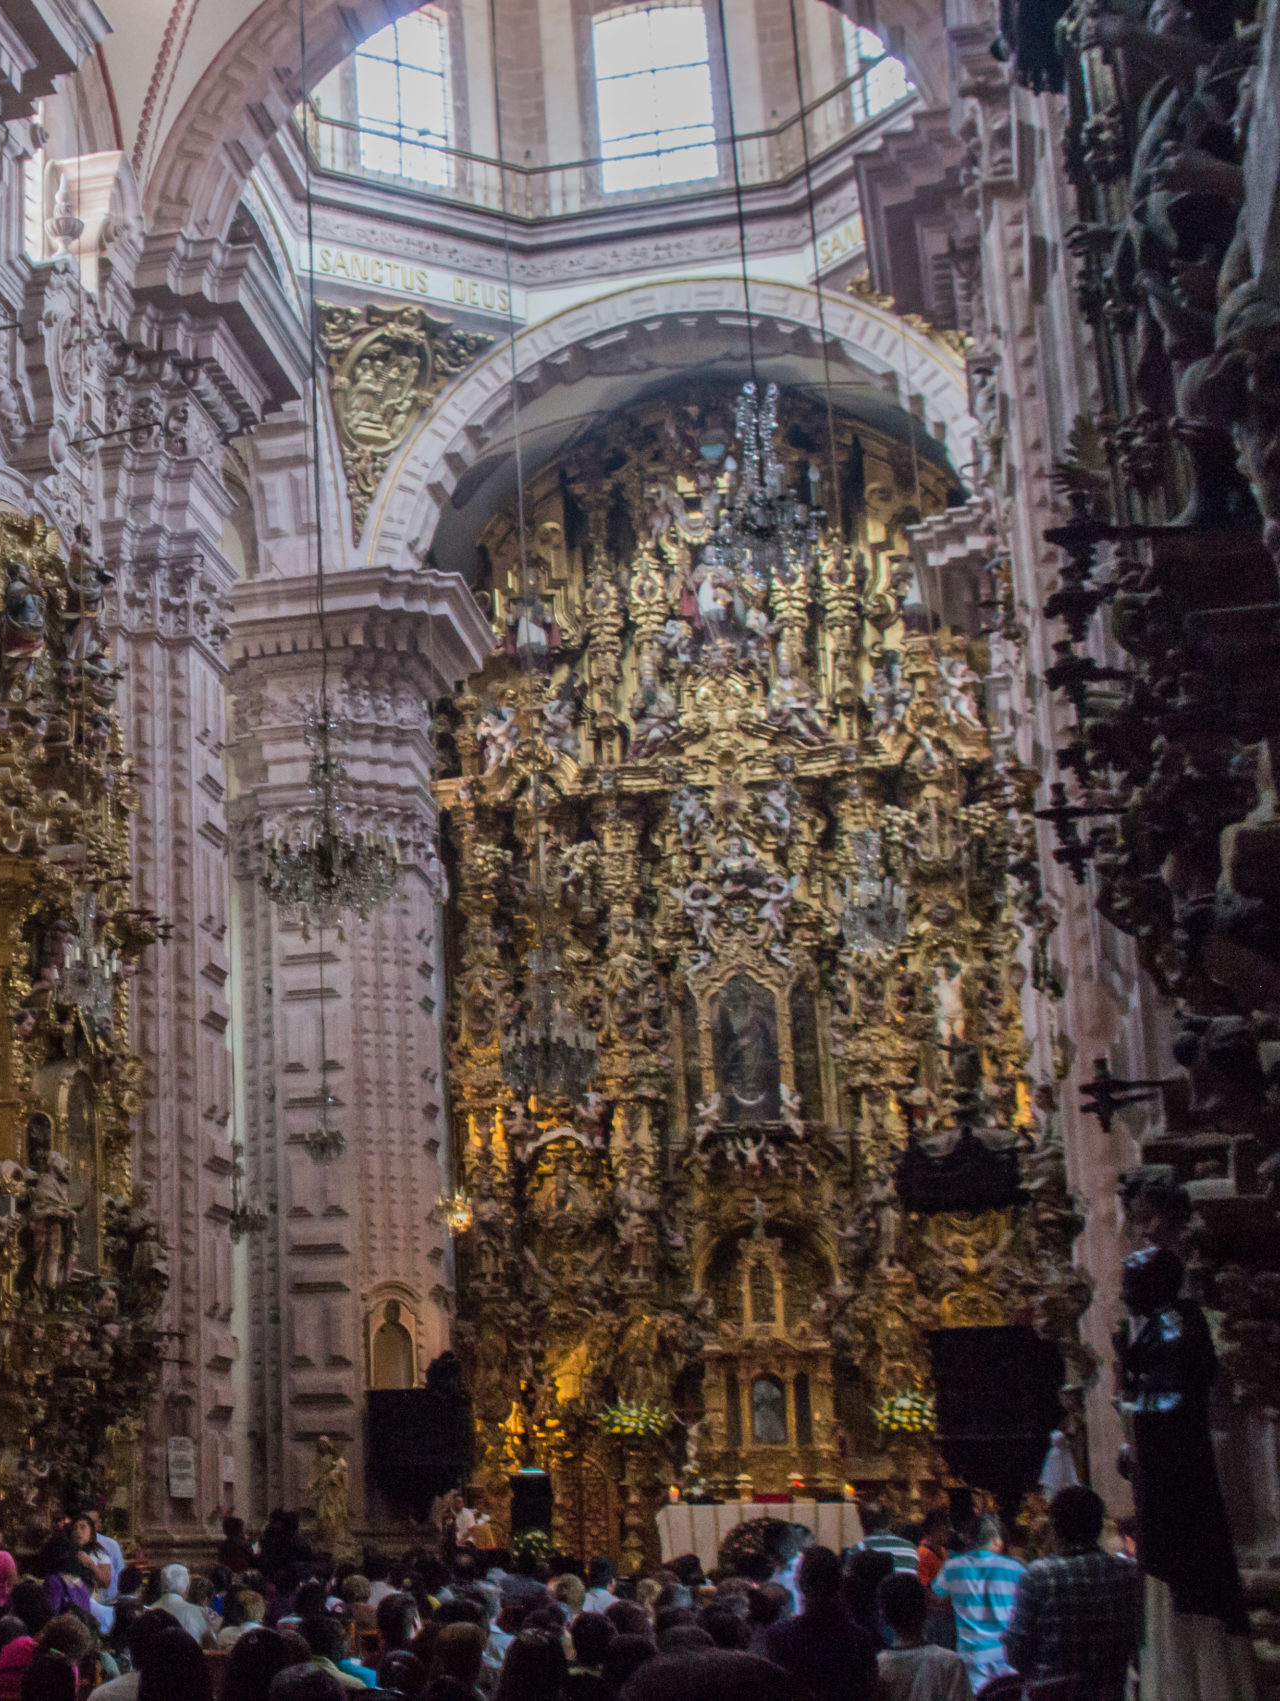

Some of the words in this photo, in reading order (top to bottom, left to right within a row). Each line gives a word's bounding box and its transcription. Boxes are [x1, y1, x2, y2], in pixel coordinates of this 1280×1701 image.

[819, 219, 863, 264] SAN
[320, 249, 428, 293] SANCTUS
[454, 278, 510, 311] DEUS
